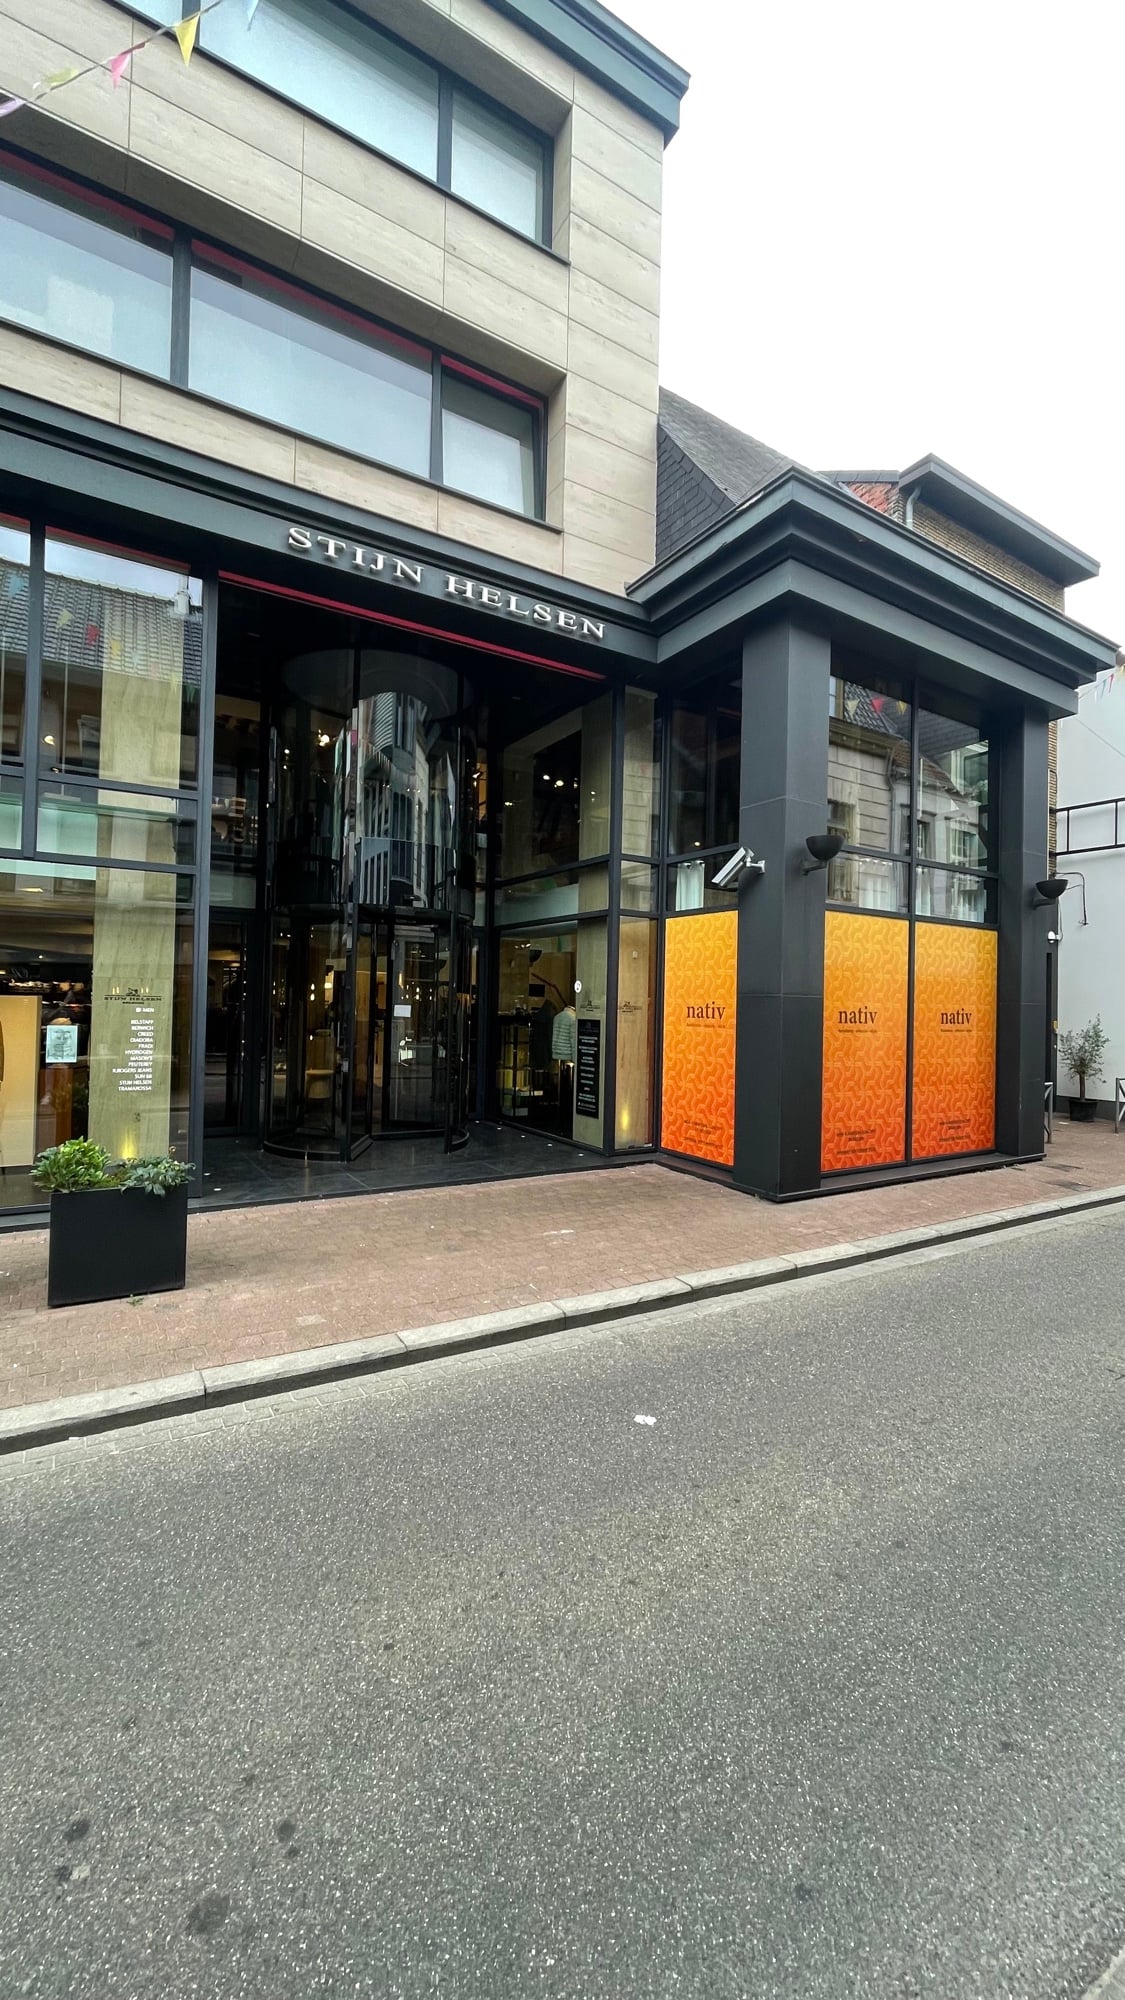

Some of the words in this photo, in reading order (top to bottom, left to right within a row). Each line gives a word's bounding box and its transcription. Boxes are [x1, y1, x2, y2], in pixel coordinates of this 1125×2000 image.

[288, 527, 425, 584] STIJN
[445, 574, 606, 639] HELSEN
[686, 1001, 726, 1020] nativ
[838, 1005, 878, 1025] nativ
[940, 1007, 973, 1025] nativ
